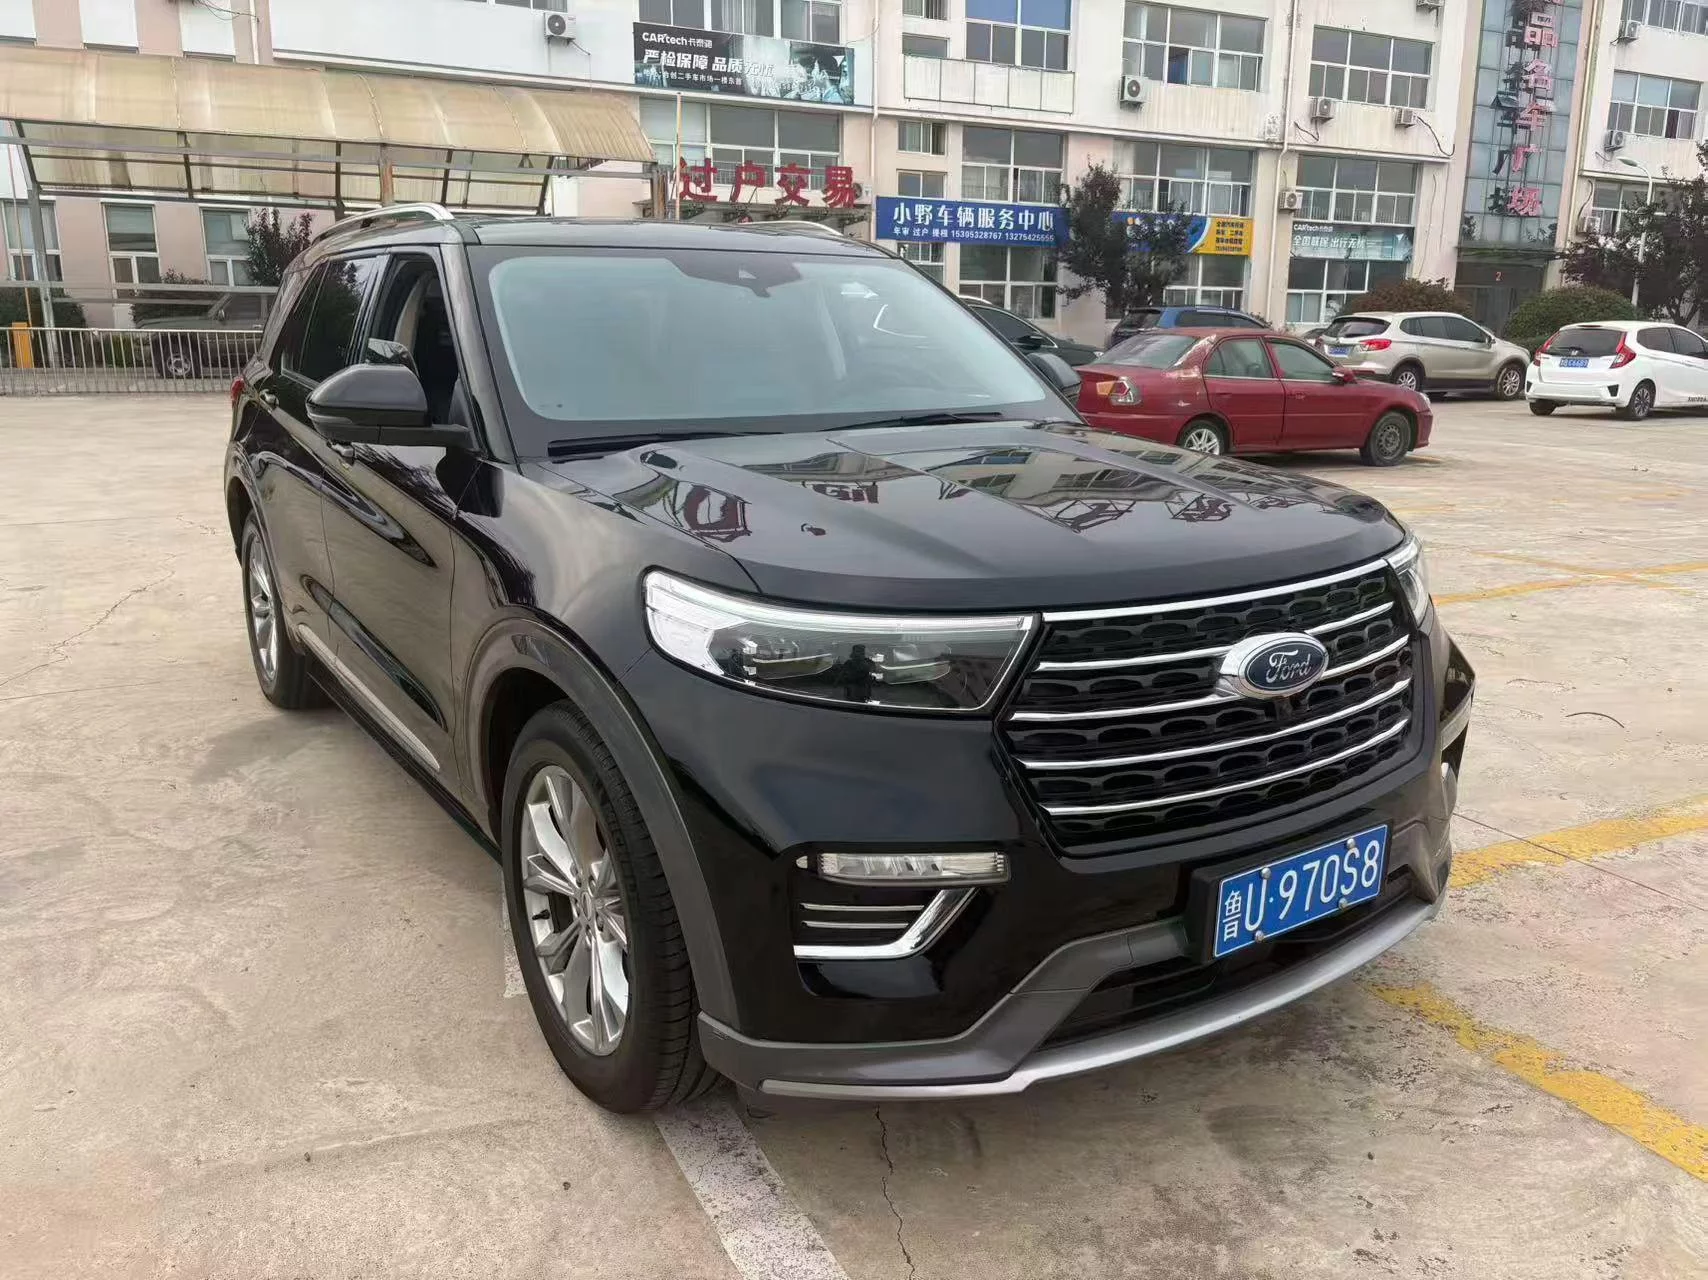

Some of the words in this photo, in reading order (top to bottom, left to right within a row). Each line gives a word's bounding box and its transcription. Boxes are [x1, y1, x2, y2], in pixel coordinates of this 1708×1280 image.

[643, 49, 709, 71] 严检保障
[679, 156, 855, 209] 过户交易
[893, 202, 1054, 231] 小野车辆服务中心
[893, 226, 910, 237] 年审
[913, 227, 929, 237] 过户
[1292, 235, 1329, 248] 全国联保
[1265, 649, 1312, 684] Ford
